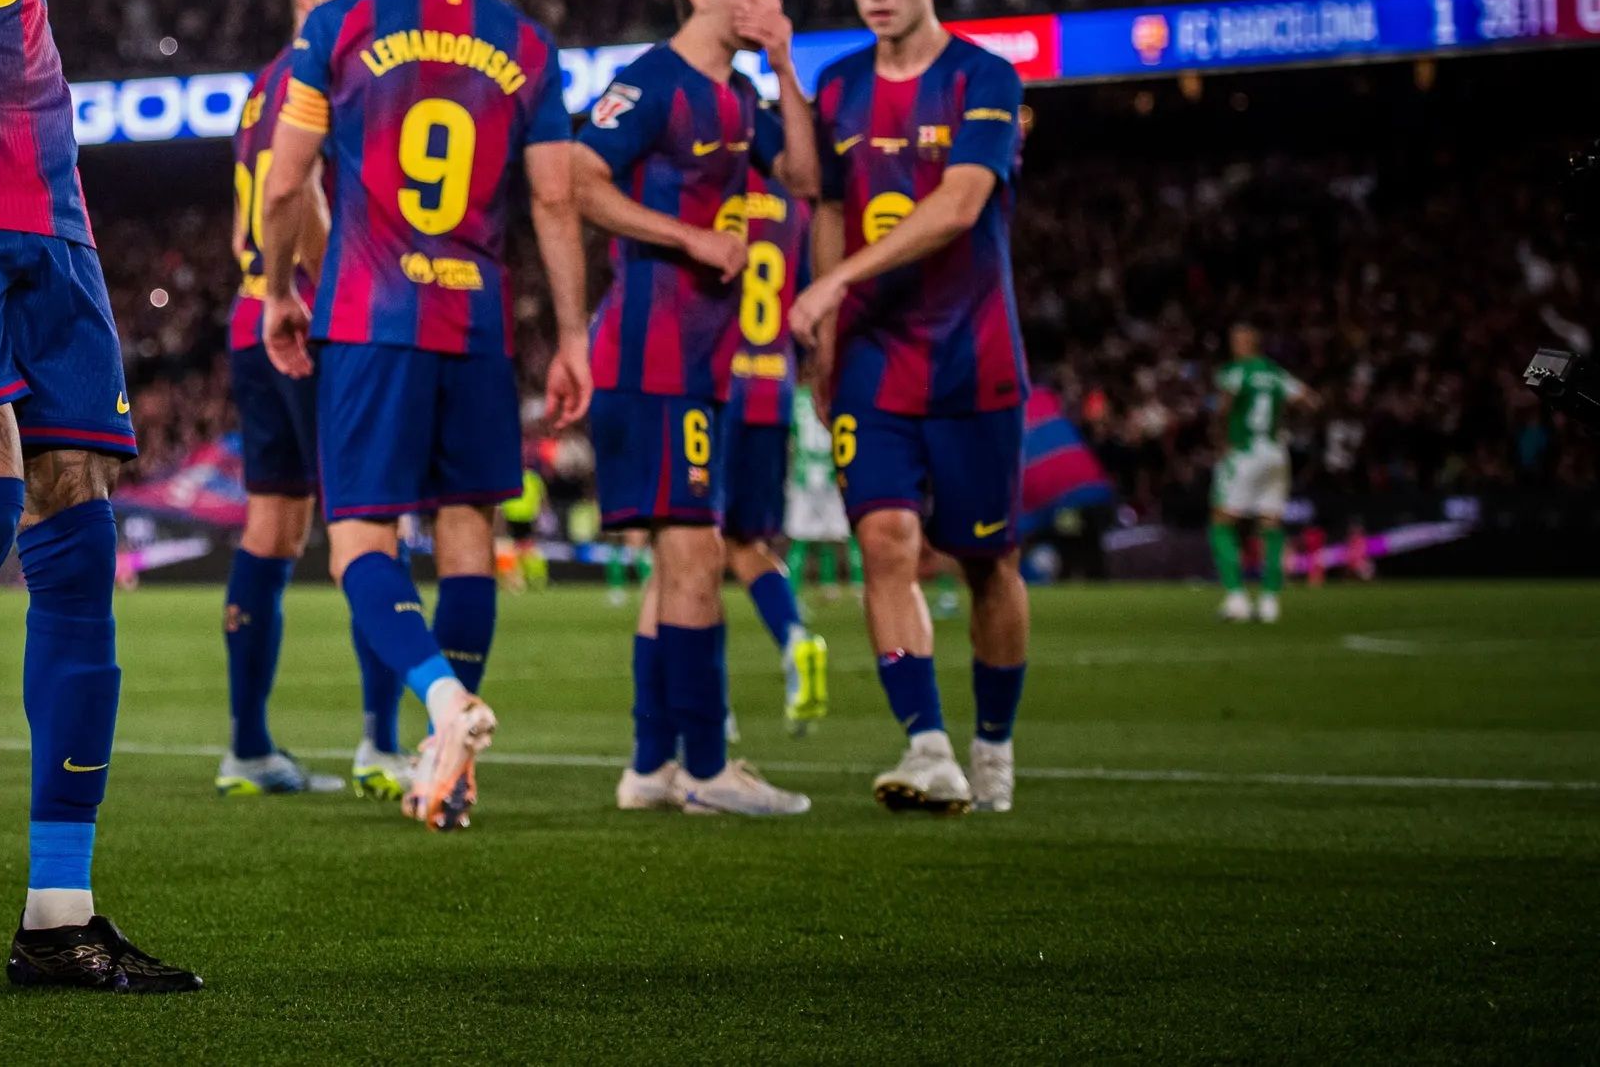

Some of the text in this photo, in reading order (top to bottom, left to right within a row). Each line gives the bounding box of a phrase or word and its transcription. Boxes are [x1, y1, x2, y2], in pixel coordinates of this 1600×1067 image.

[361, 29, 527, 95] LEWANDOWSKI
[398, 98, 477, 235] 9
[739, 241, 786, 345] 8
[683, 409, 711, 466] 6
[833, 414, 858, 467] 6
